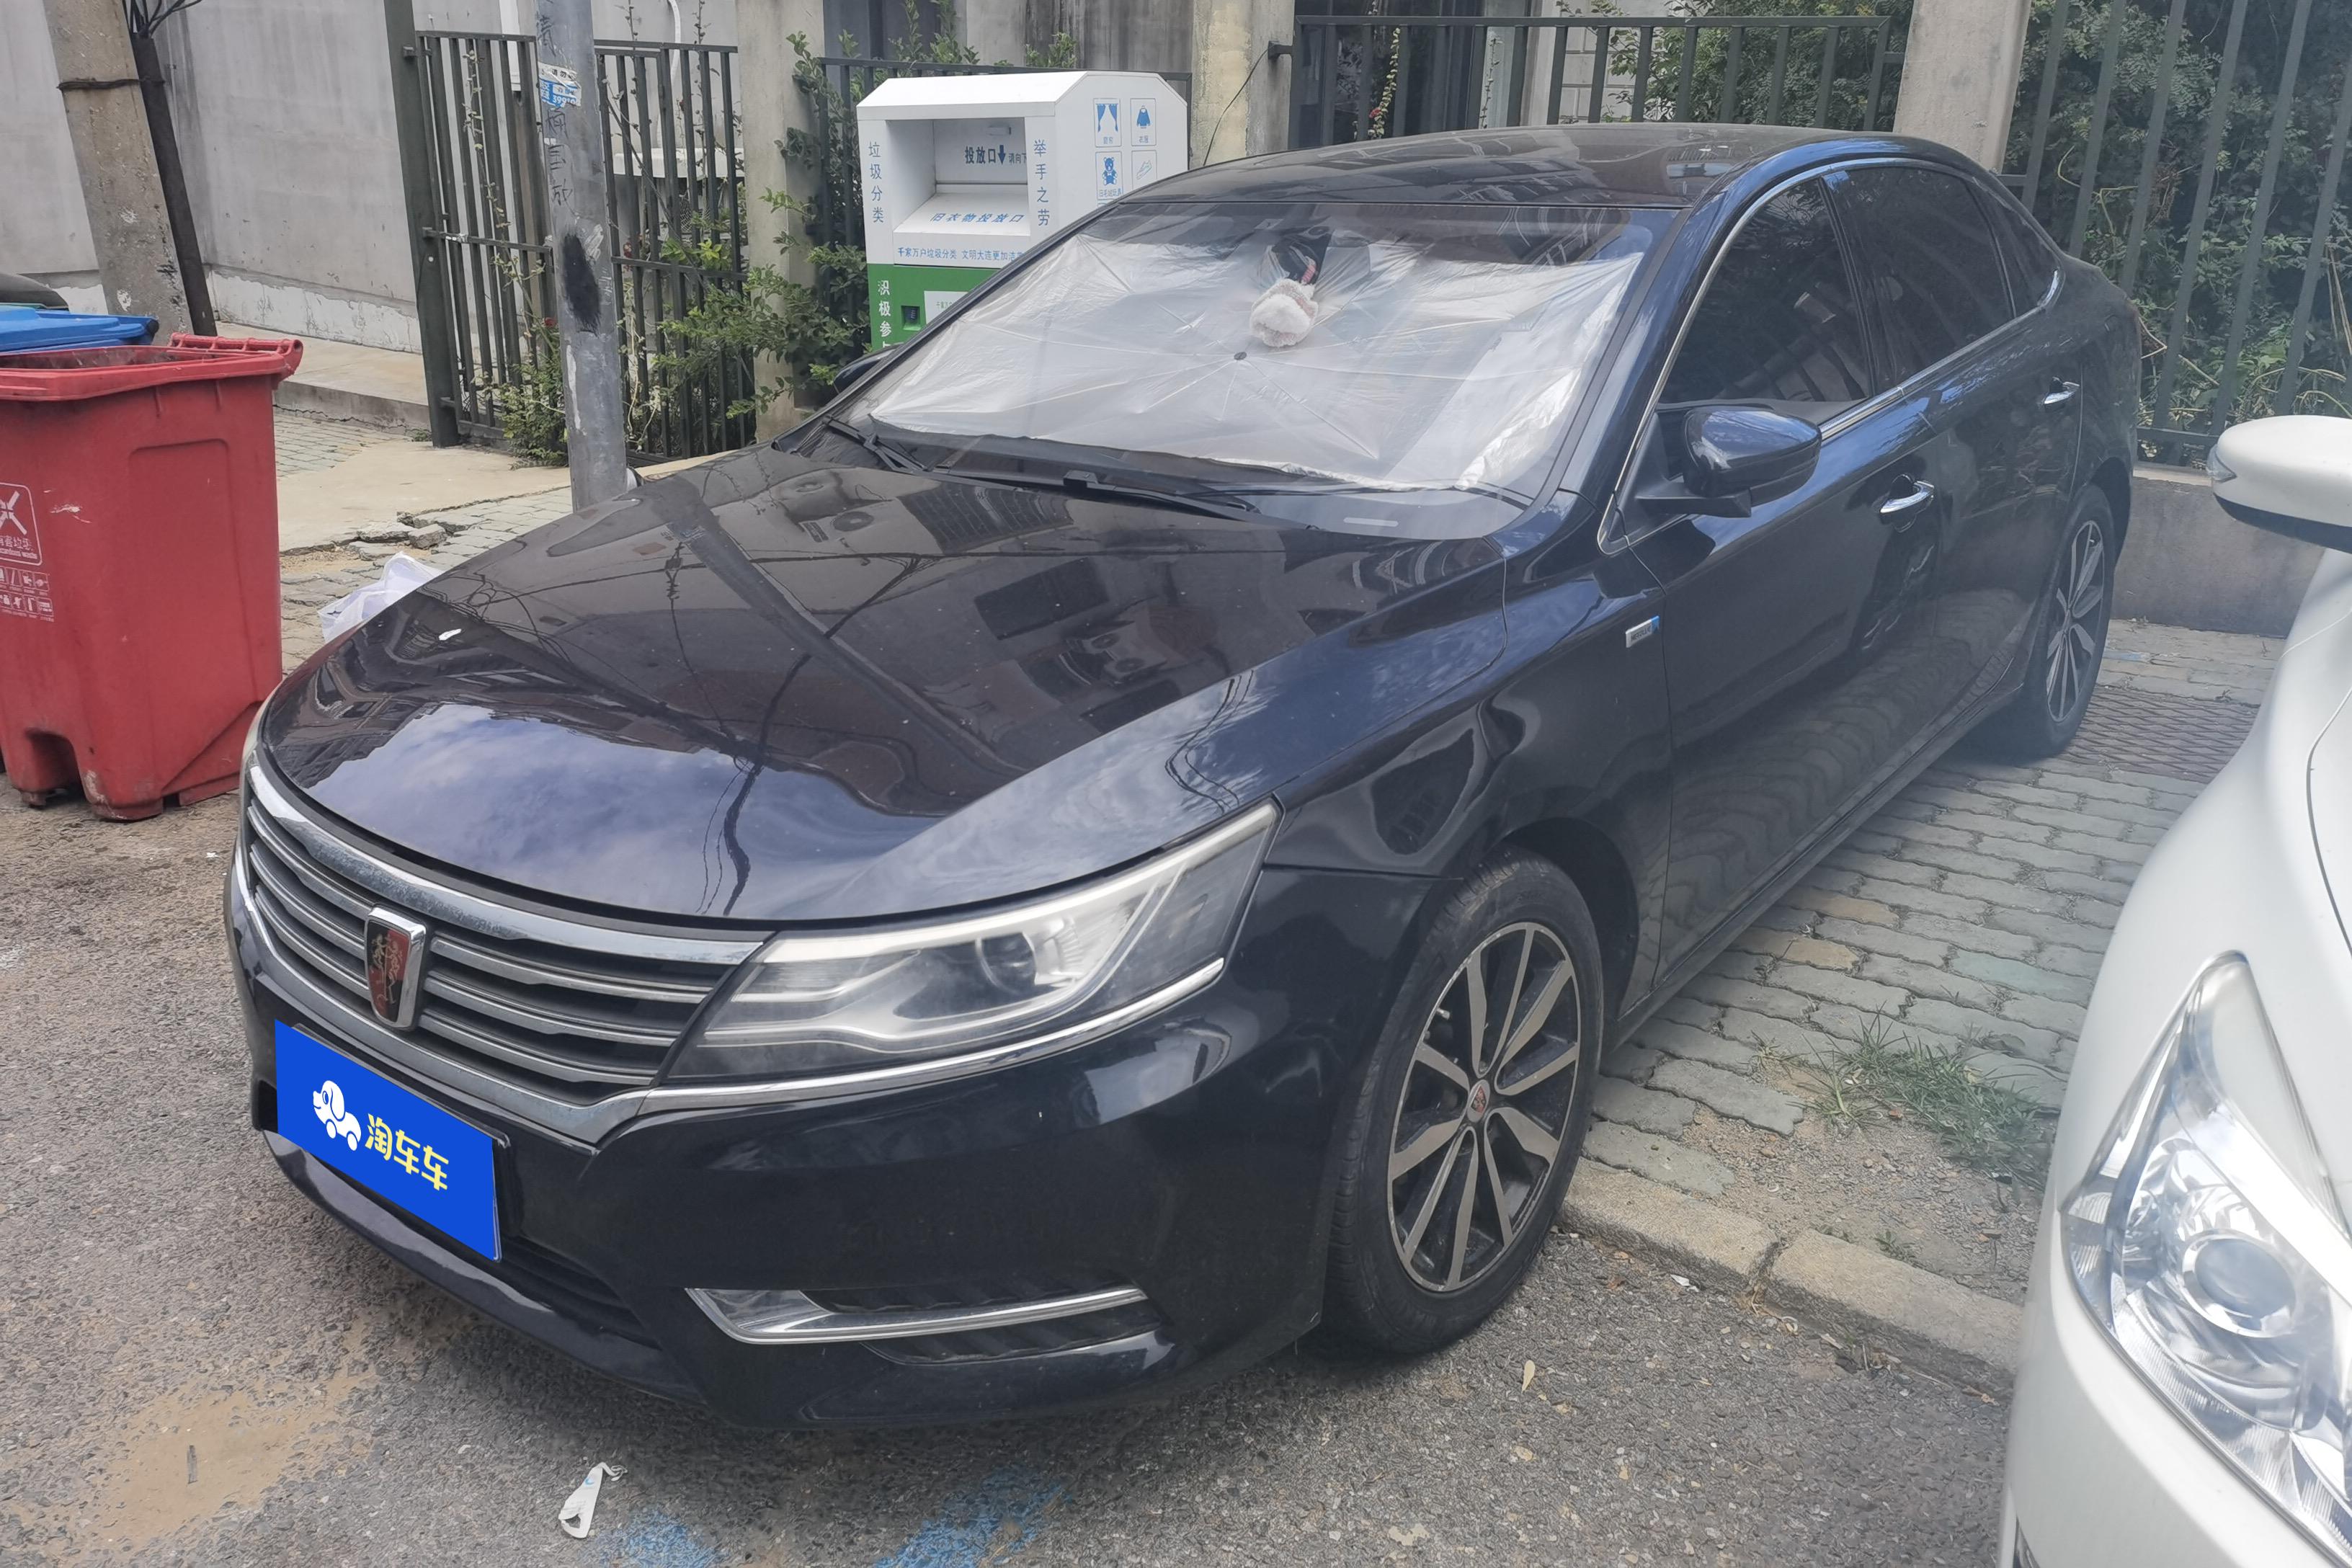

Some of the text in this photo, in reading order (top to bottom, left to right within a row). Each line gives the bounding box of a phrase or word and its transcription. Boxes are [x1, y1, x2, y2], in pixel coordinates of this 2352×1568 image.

[964, 146, 997, 164] 投放口
[868, 141, 884, 223] 垃圾分类
[1033, 139, 1050, 226] 举手之劳
[930, 213, 1025, 223] 旧衣物投放口
[898, 246, 958, 259] 千家万户垃圾分类
